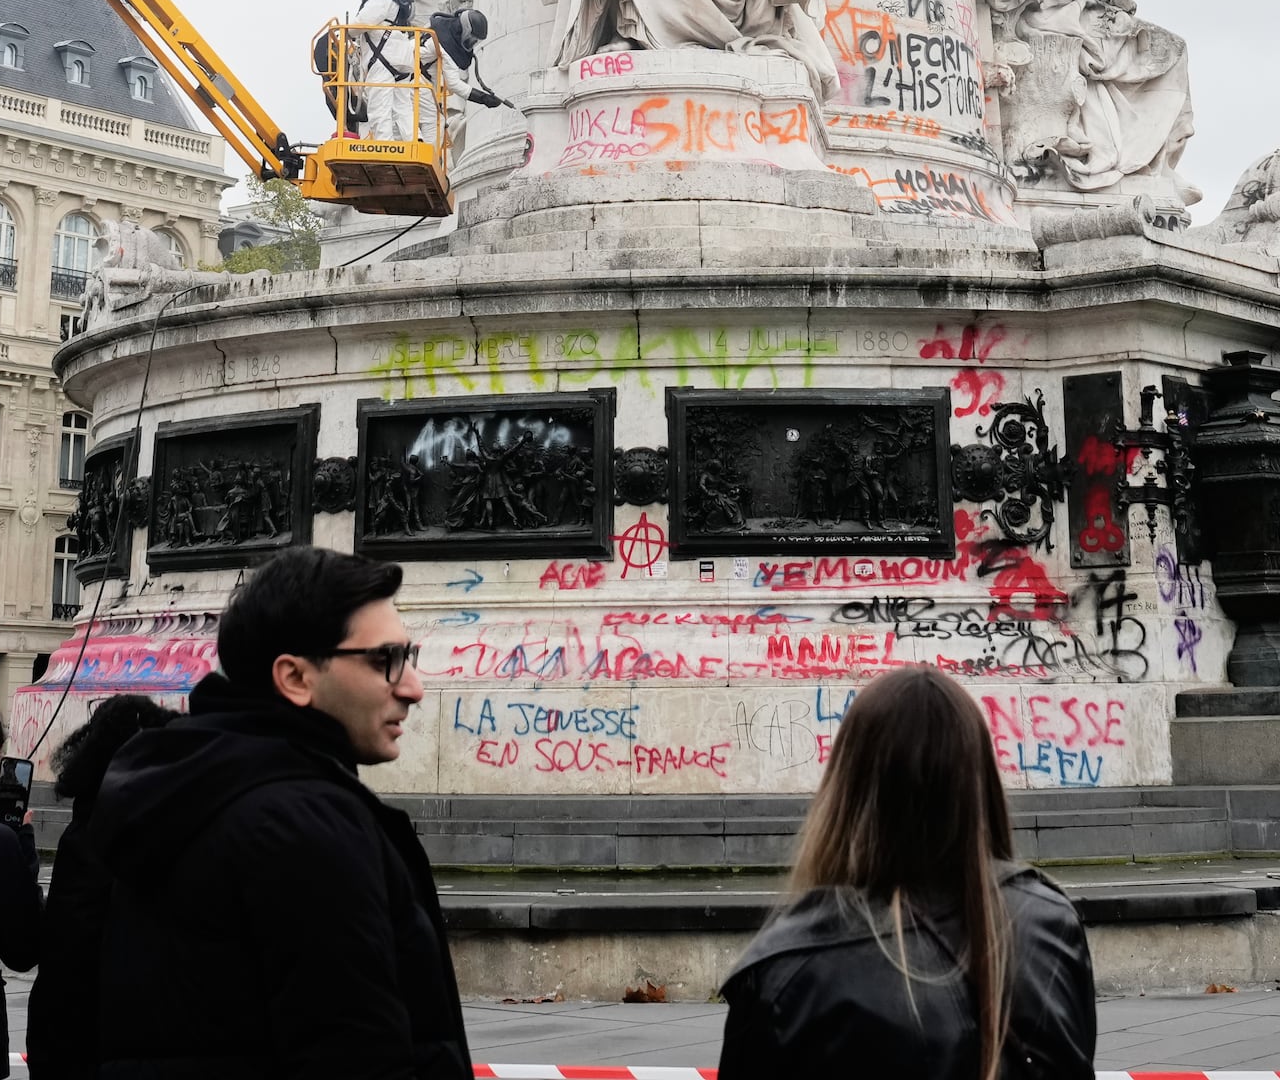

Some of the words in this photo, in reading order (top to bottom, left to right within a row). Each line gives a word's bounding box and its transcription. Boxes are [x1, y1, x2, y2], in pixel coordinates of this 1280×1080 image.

[580, 52, 634, 80] ACAB
[906, 33, 974, 77] ECRIT
[394, 336, 531, 365] SEPTEMBRE
[546, 334, 598, 357] 1870
[708, 330, 728, 352] 14
[739, 330, 844, 352] JUILLET
[855, 330, 909, 352] 1880
[192, 359, 236, 385] MARS
[245, 355, 281, 378] 1848
[454, 697, 496, 735] LA
[508, 702, 639, 739] JEUNESSE
[730, 700, 818, 771] ACAB
[476, 739, 519, 768] EN
[1055, 746, 1103, 782] FN
